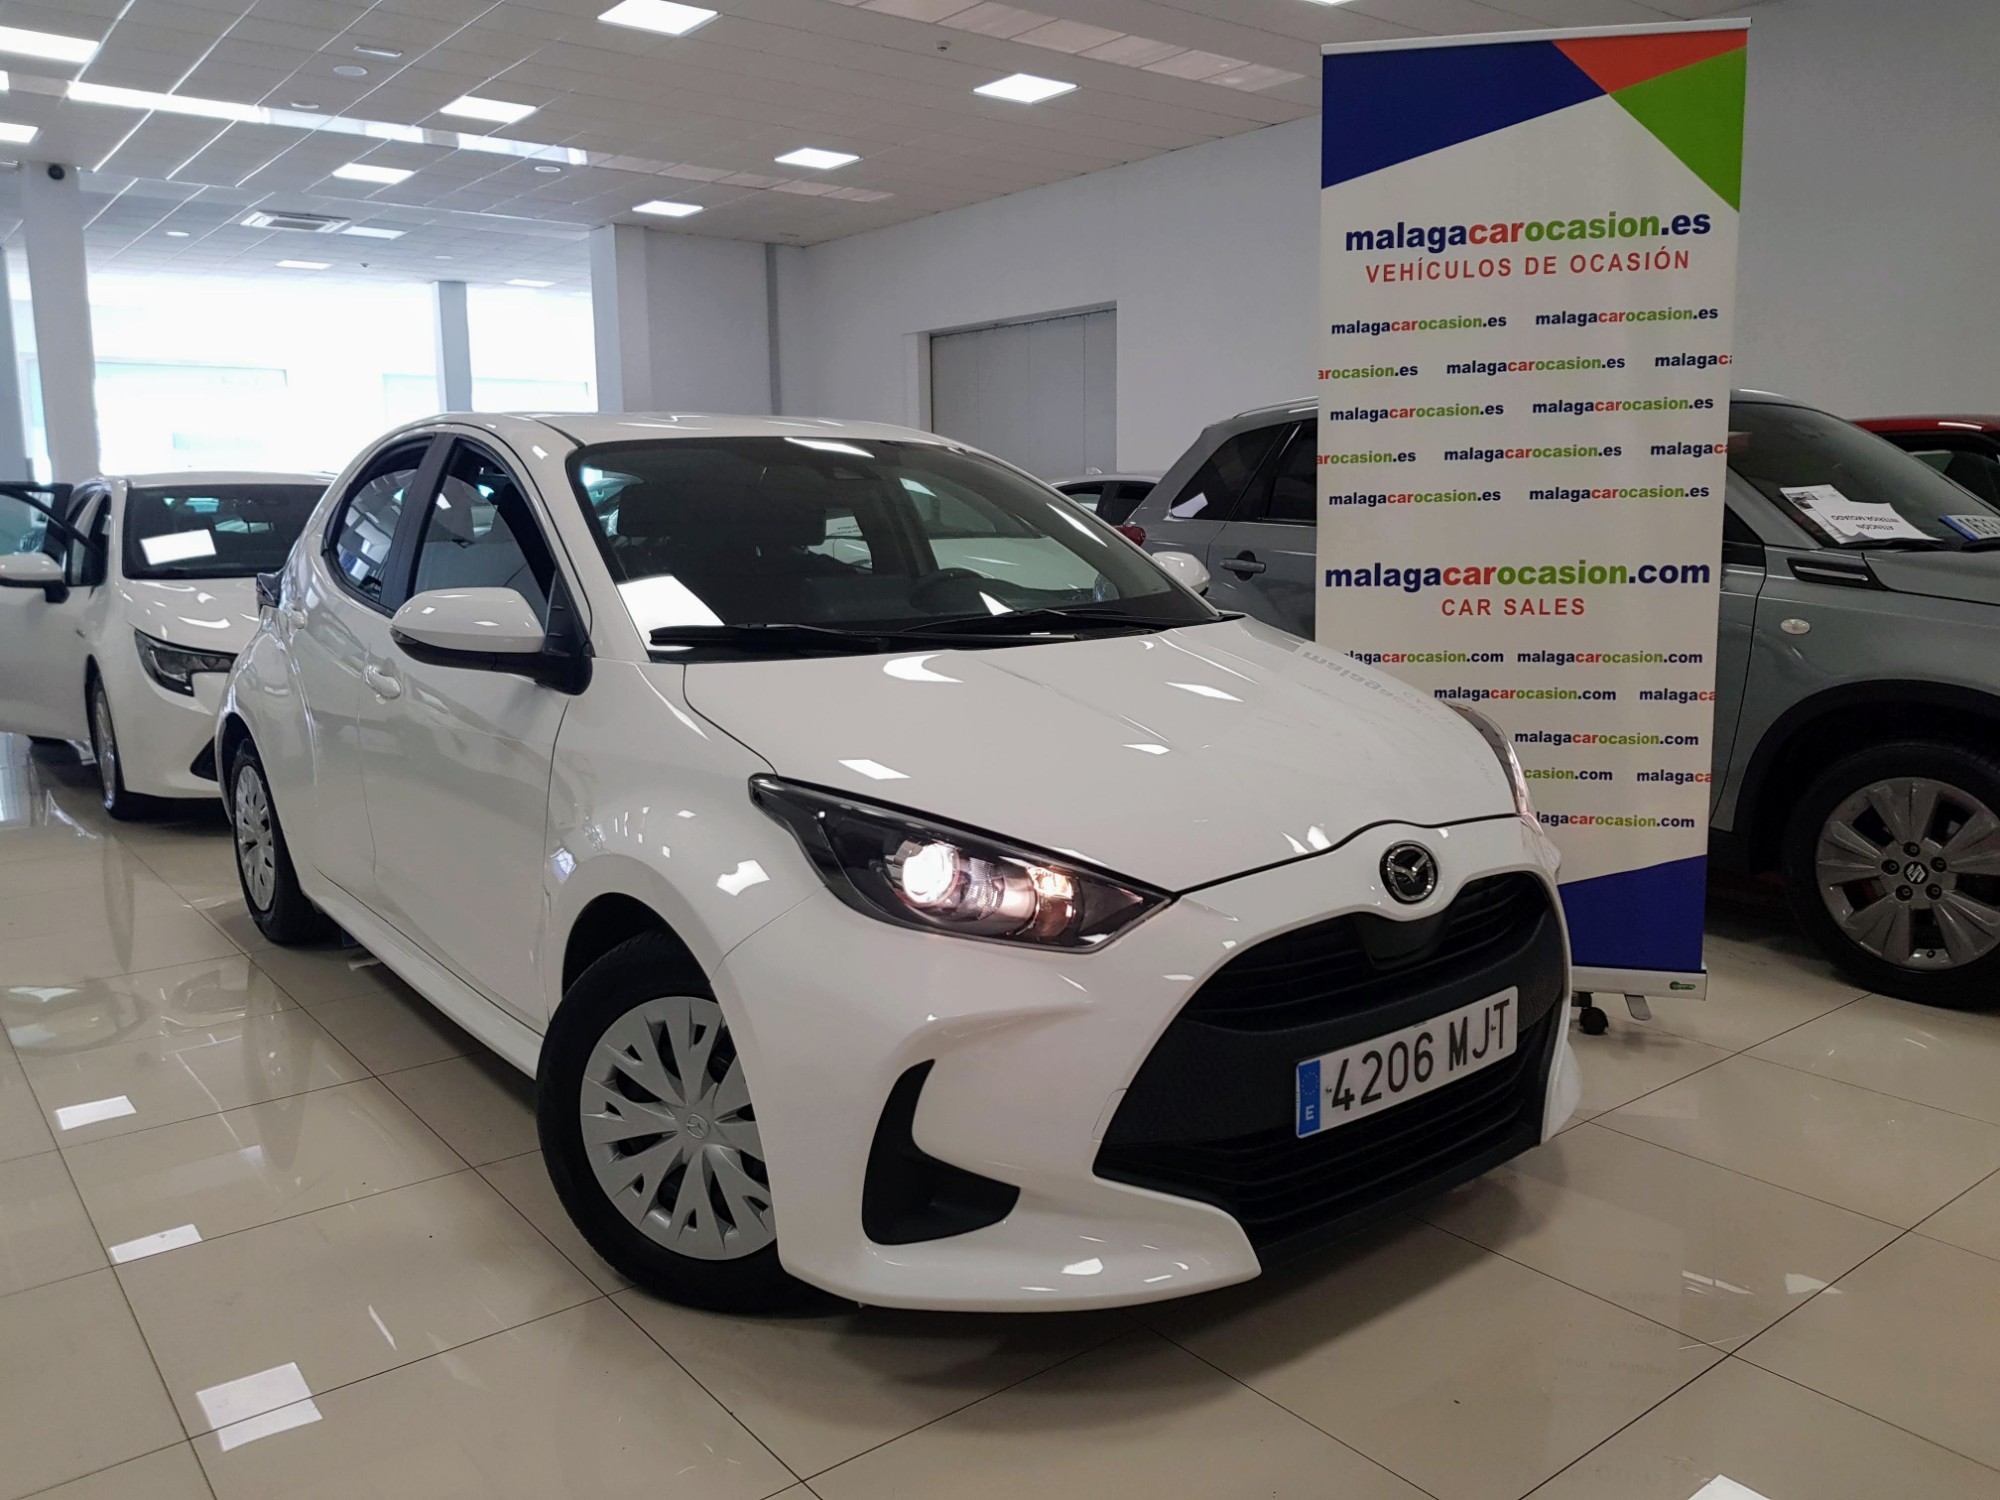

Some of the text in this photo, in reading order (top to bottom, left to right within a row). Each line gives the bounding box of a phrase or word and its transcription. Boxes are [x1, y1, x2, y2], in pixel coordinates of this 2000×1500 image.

[1346, 211, 1711, 255] malagacarocasion.es
[1366, 246, 1690, 283] VEHÍCULOS DE OCASIÓN
[1332, 315, 1507, 336] malagacarocasion.es
[1536, 307, 1718, 327] malagacarocasion.es
[1447, 356, 1625, 376] malagacarocasion.es
[1330, 403, 1504, 423] malagacarocasion.es
[1533, 397, 1713, 416] malagacarocasion.es
[1444, 444, 1622, 463] malagacarocasion.es
[1329, 489, 1501, 507] malagacarocasion.es
[1530, 485, 1709, 502] malagacarocasion.es
[1325, 559, 1710, 593] malagacarocasion.com
[1442, 598, 1584, 616] CAR SALES
[1517, 650, 1702, 666] malagacarocasion.com
[1434, 686, 1616, 702] malagacarocasion.com
[1515, 730, 1698, 746] malagacarocasion.com
[1332, 999, 1510, 1111] 4206 MJT
[1305, 1104, 1315, 1121] E
